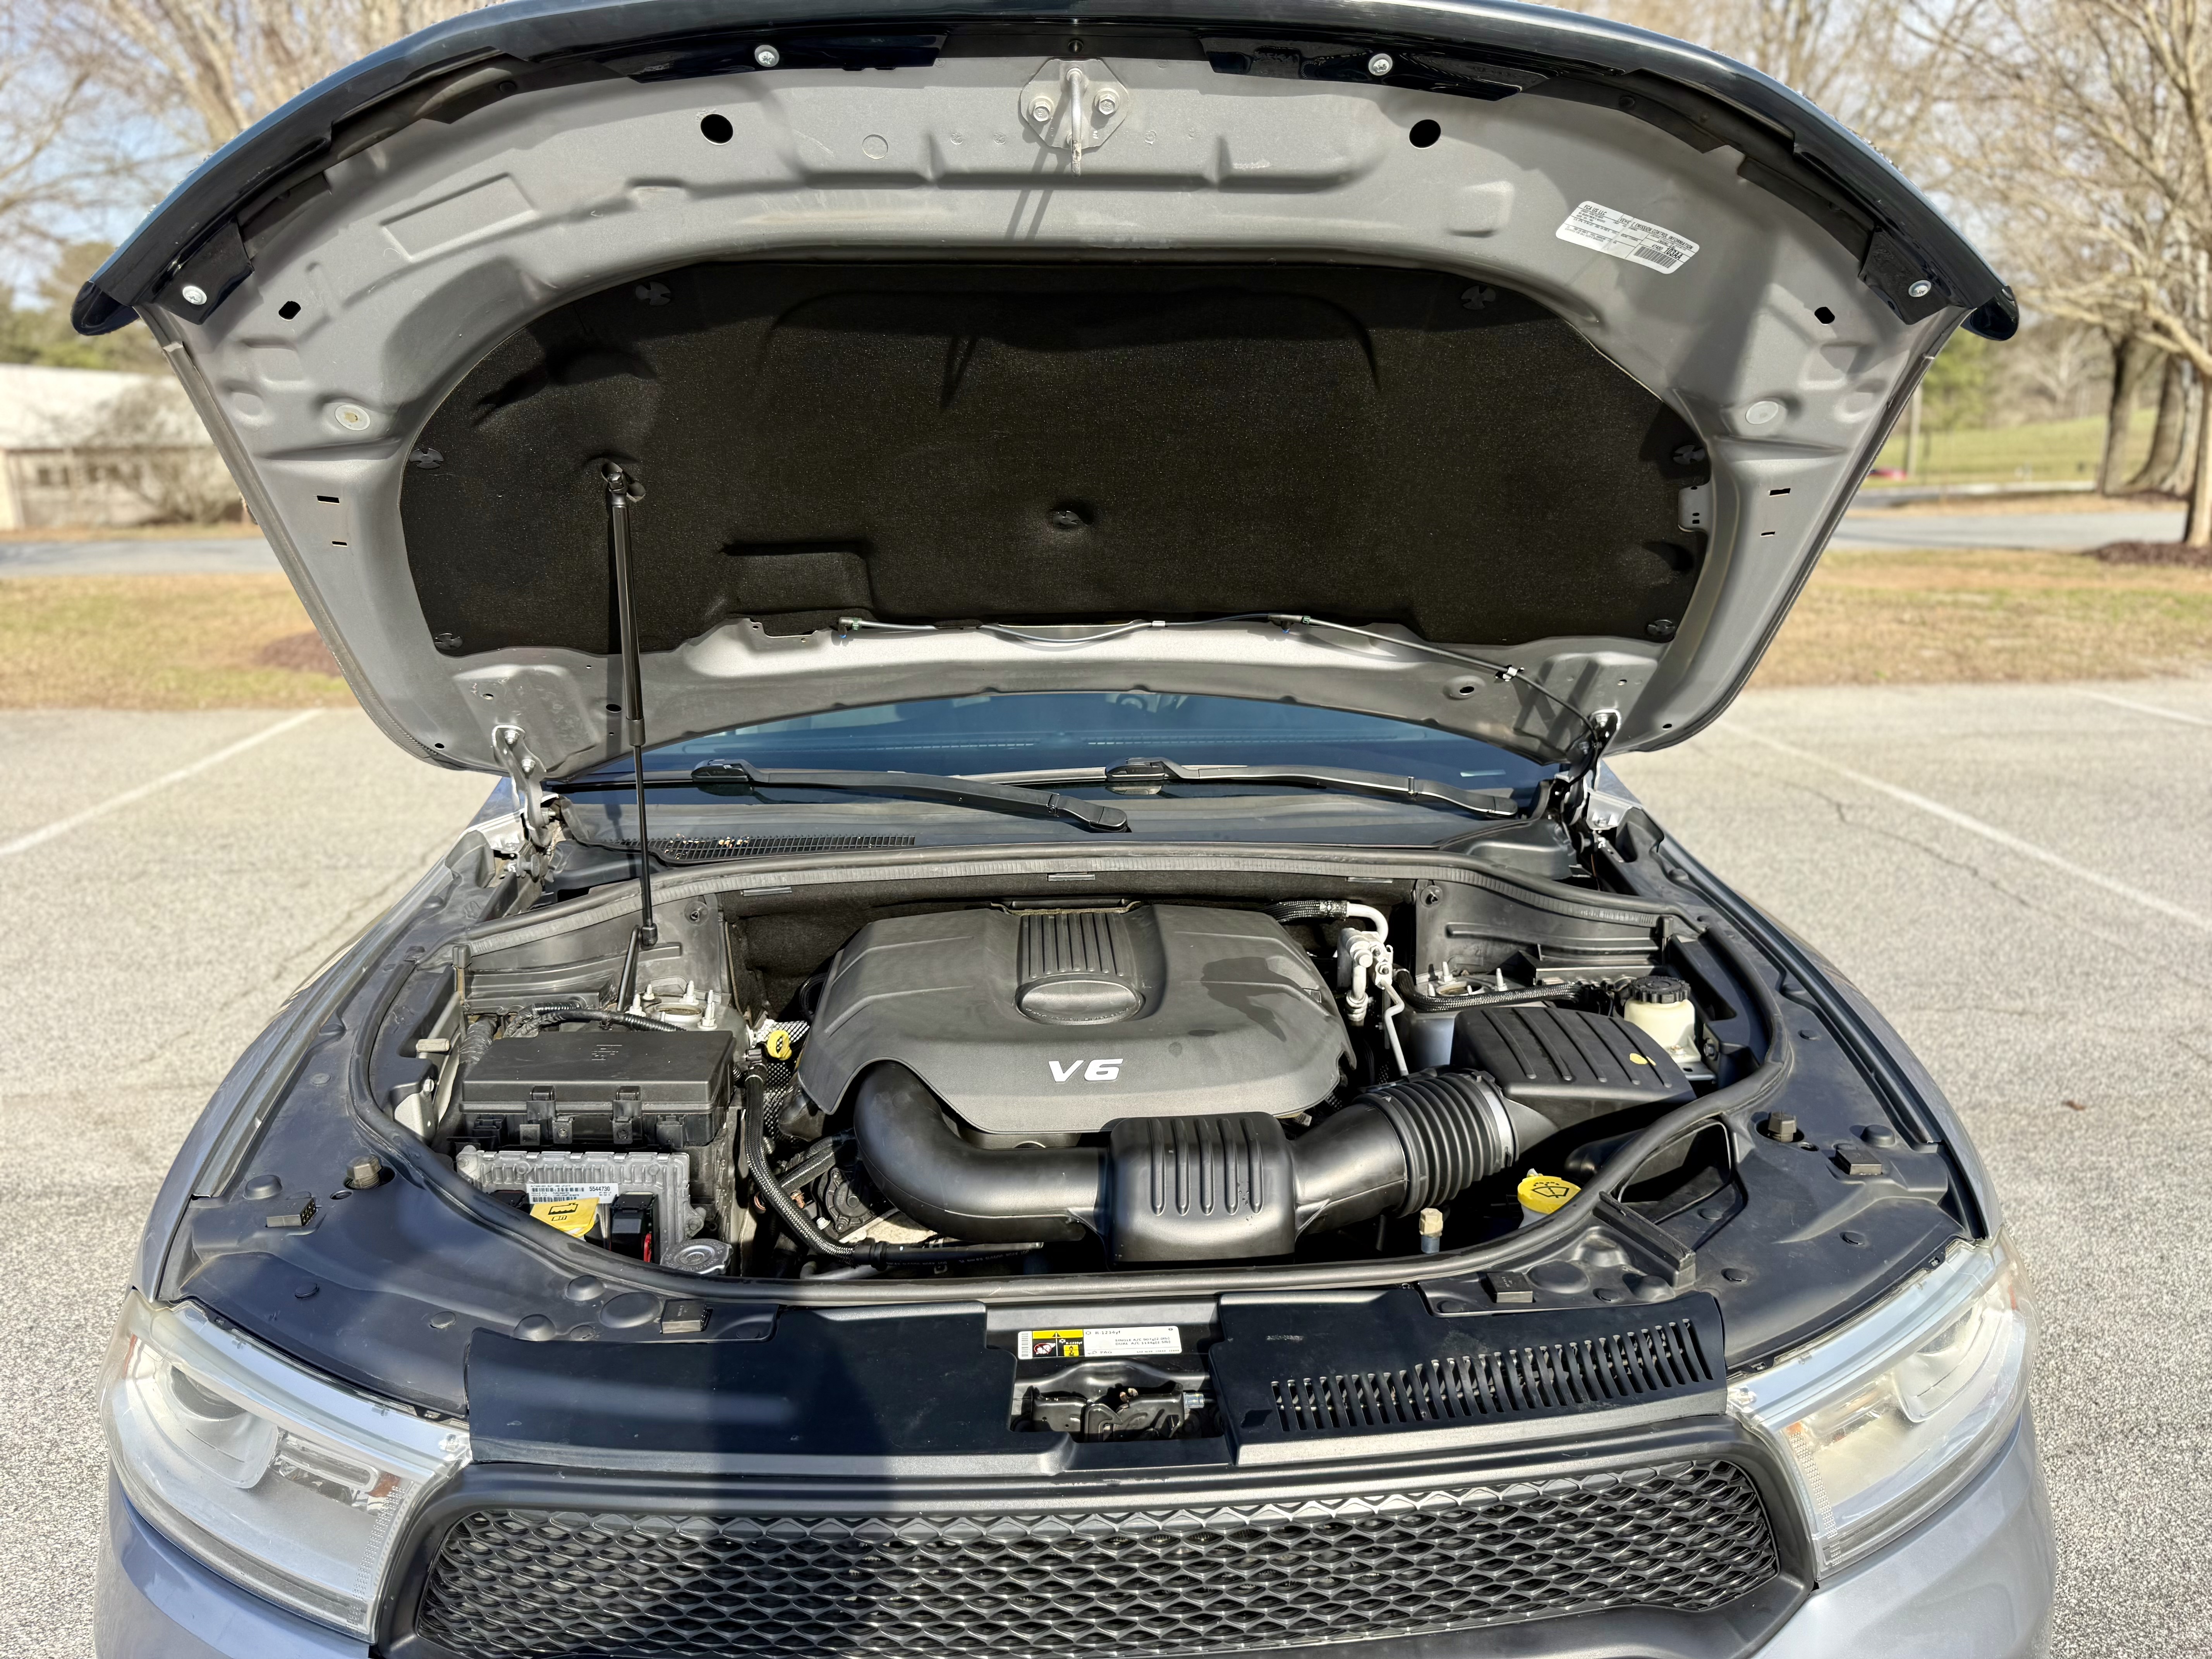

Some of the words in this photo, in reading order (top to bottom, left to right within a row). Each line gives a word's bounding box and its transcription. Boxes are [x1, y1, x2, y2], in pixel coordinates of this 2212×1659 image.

[1635, 223, 1652, 232] EMISSION
[1652, 229, 1668, 238] CONTROL
[1668, 235, 1693, 250] INFORMATION
[1664, 247, 1683, 260] 103AA
[1048, 1058, 1124, 1082] V6
